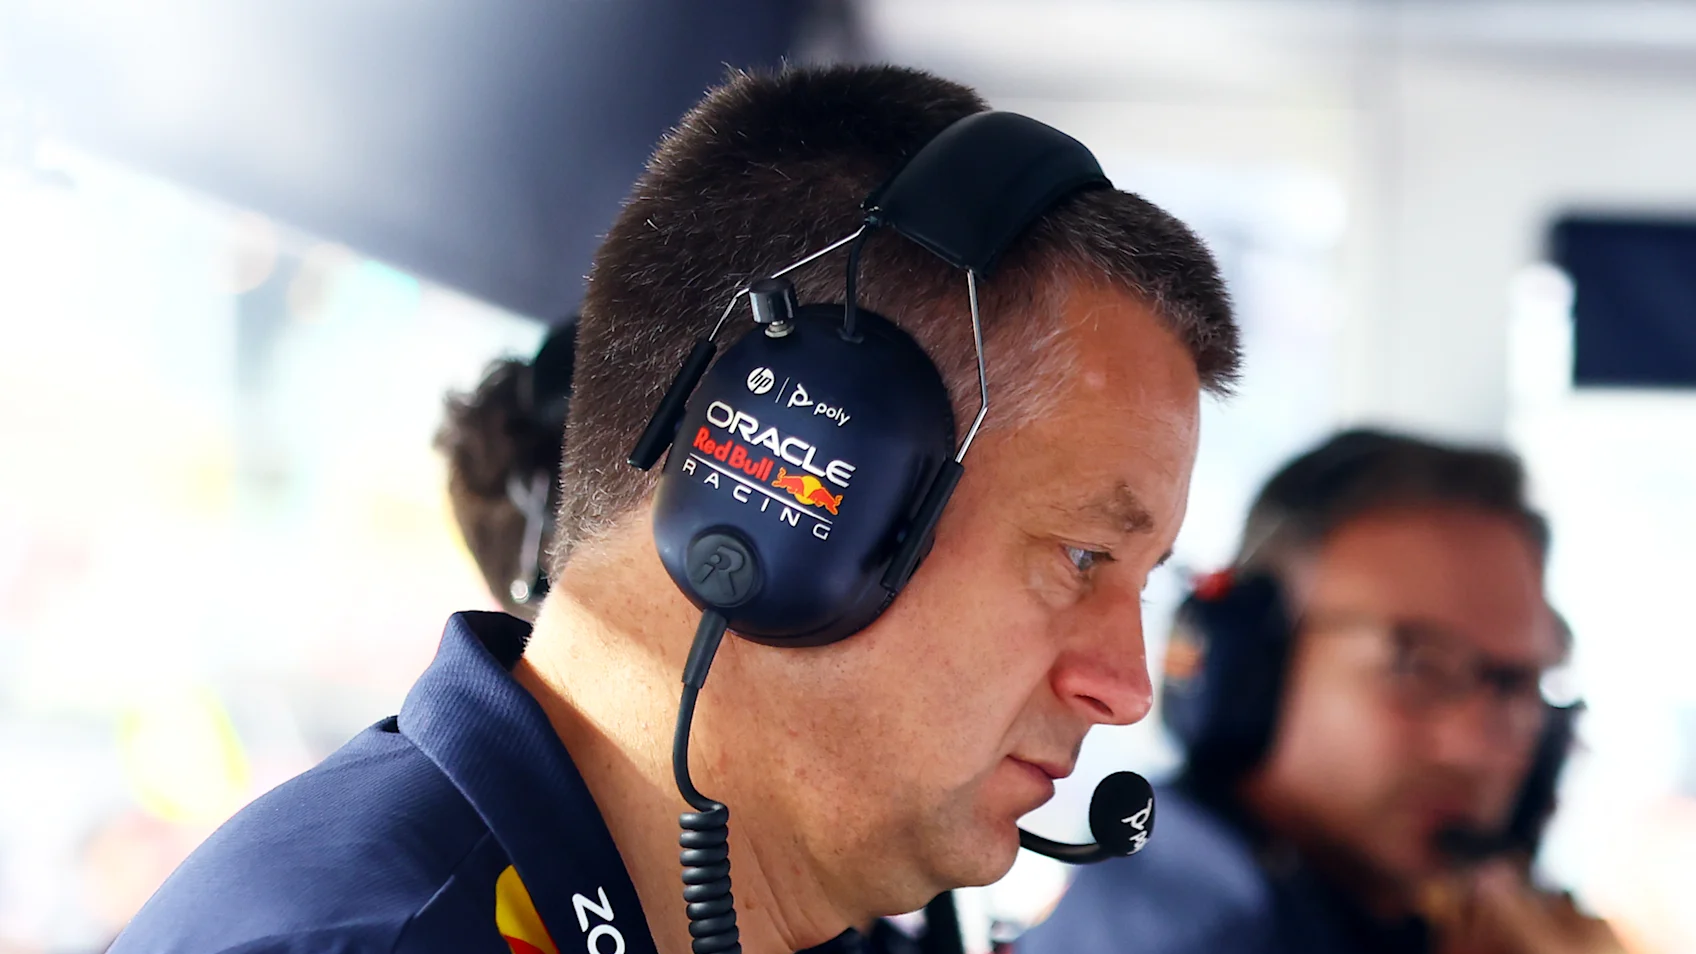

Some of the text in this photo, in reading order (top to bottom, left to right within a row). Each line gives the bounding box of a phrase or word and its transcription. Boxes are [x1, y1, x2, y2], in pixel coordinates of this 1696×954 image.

[747, 367, 851, 427] hp poly
[692, 426, 774, 482] Red Bull
[706, 401, 856, 488] ORACLE
[682, 458, 832, 540] RACING
